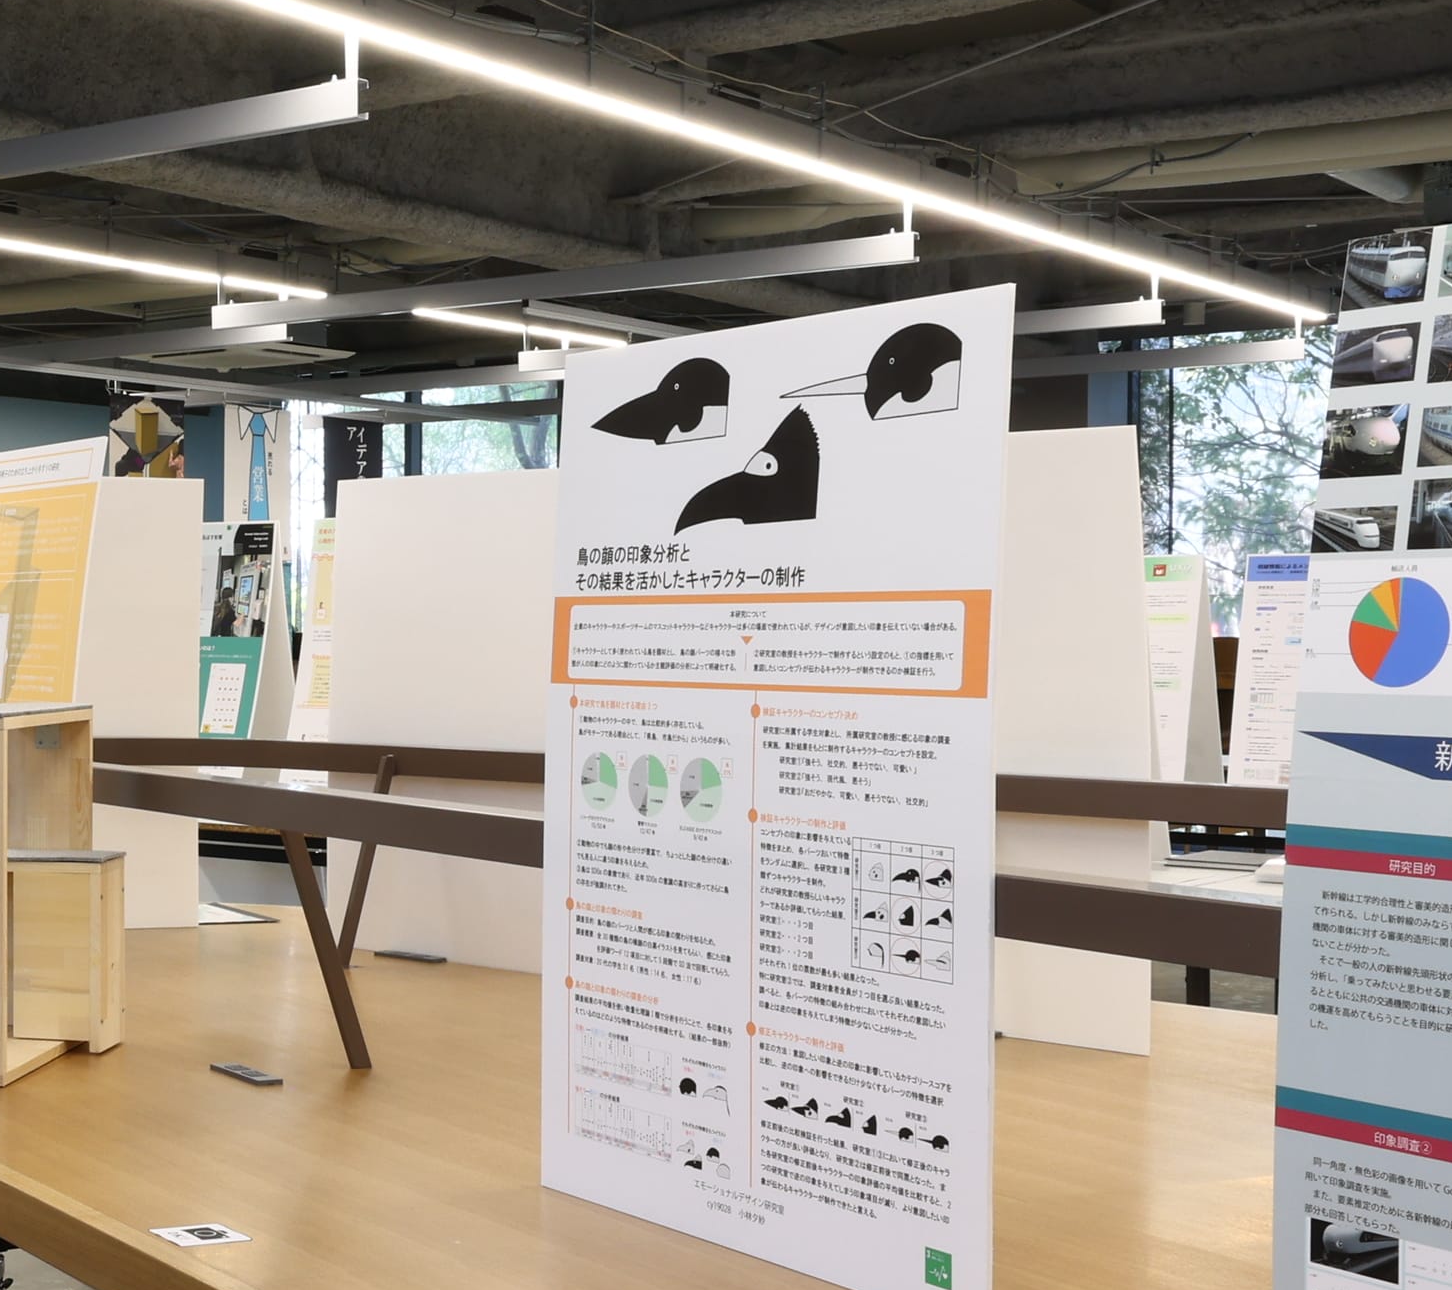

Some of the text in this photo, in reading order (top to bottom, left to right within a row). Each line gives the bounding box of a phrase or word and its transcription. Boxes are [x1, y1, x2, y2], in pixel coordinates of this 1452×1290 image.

[577, 543, 691, 566] 鳥の顔の印象分析と
[575, 566, 806, 591] その結果を活かしたキャラクターの制作
[729, 609, 767, 619] 本研究について
[1388, 859, 1436, 877] 研究目的
[1312, 938, 1392, 958] ないことが分かった。
[1309, 1018, 1330, 1032] した。
[1373, 1130, 1433, 1155] 印象調査②
[1304, 1171, 1393, 1201] 用いて印象調査を実施。
[1312, 1156, 1442, 1194] 同一角度・無色彩の画像を用いて
[693, 1179, 785, 1216] エモーショナルデザイン研究室
[1304, 1203, 1401, 1237] 部分も回答してもらった。
